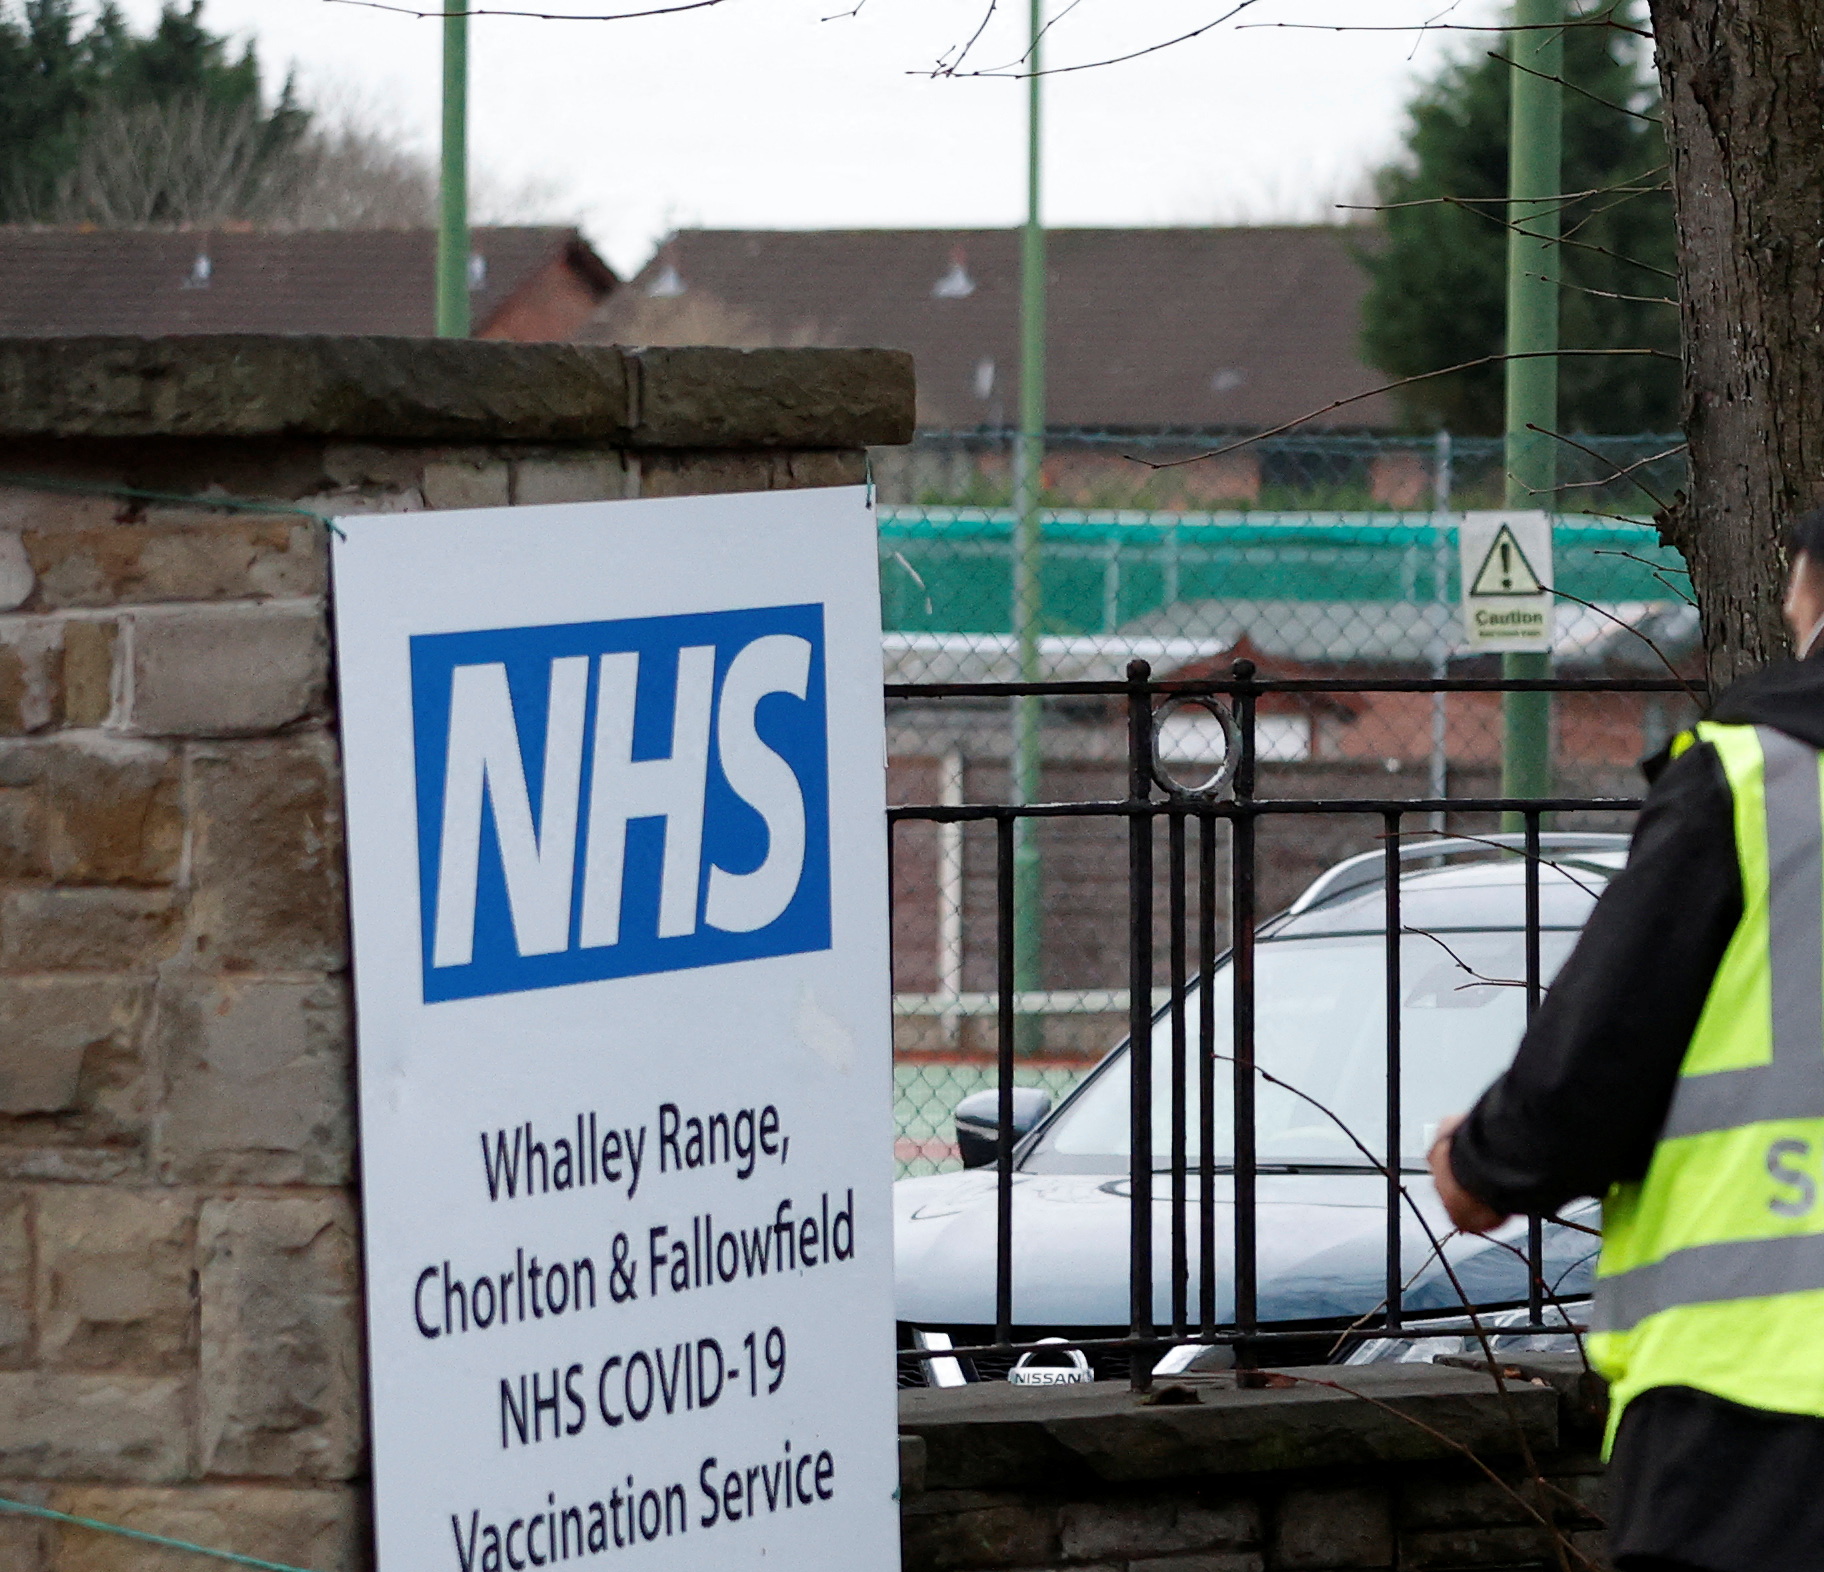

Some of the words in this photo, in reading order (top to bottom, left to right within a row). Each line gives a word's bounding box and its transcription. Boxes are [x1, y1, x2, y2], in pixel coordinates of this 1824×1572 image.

[1475, 609, 1543, 627] Caution
[433, 634, 812, 969] NHS
[481, 1111, 646, 1202] Whalley
[658, 1102, 791, 1179] Range,
[413, 1247, 596, 1339] Chorlton
[608, 1232, 638, 1303] &
[650, 1188, 856, 1297] Fallowfield
[500, 1364, 586, 1449] NHS
[598, 1325, 787, 1427] COVID-19
[1015, 1373, 1082, 1385] NISSAN
[700, 1440, 835, 1528] Service
